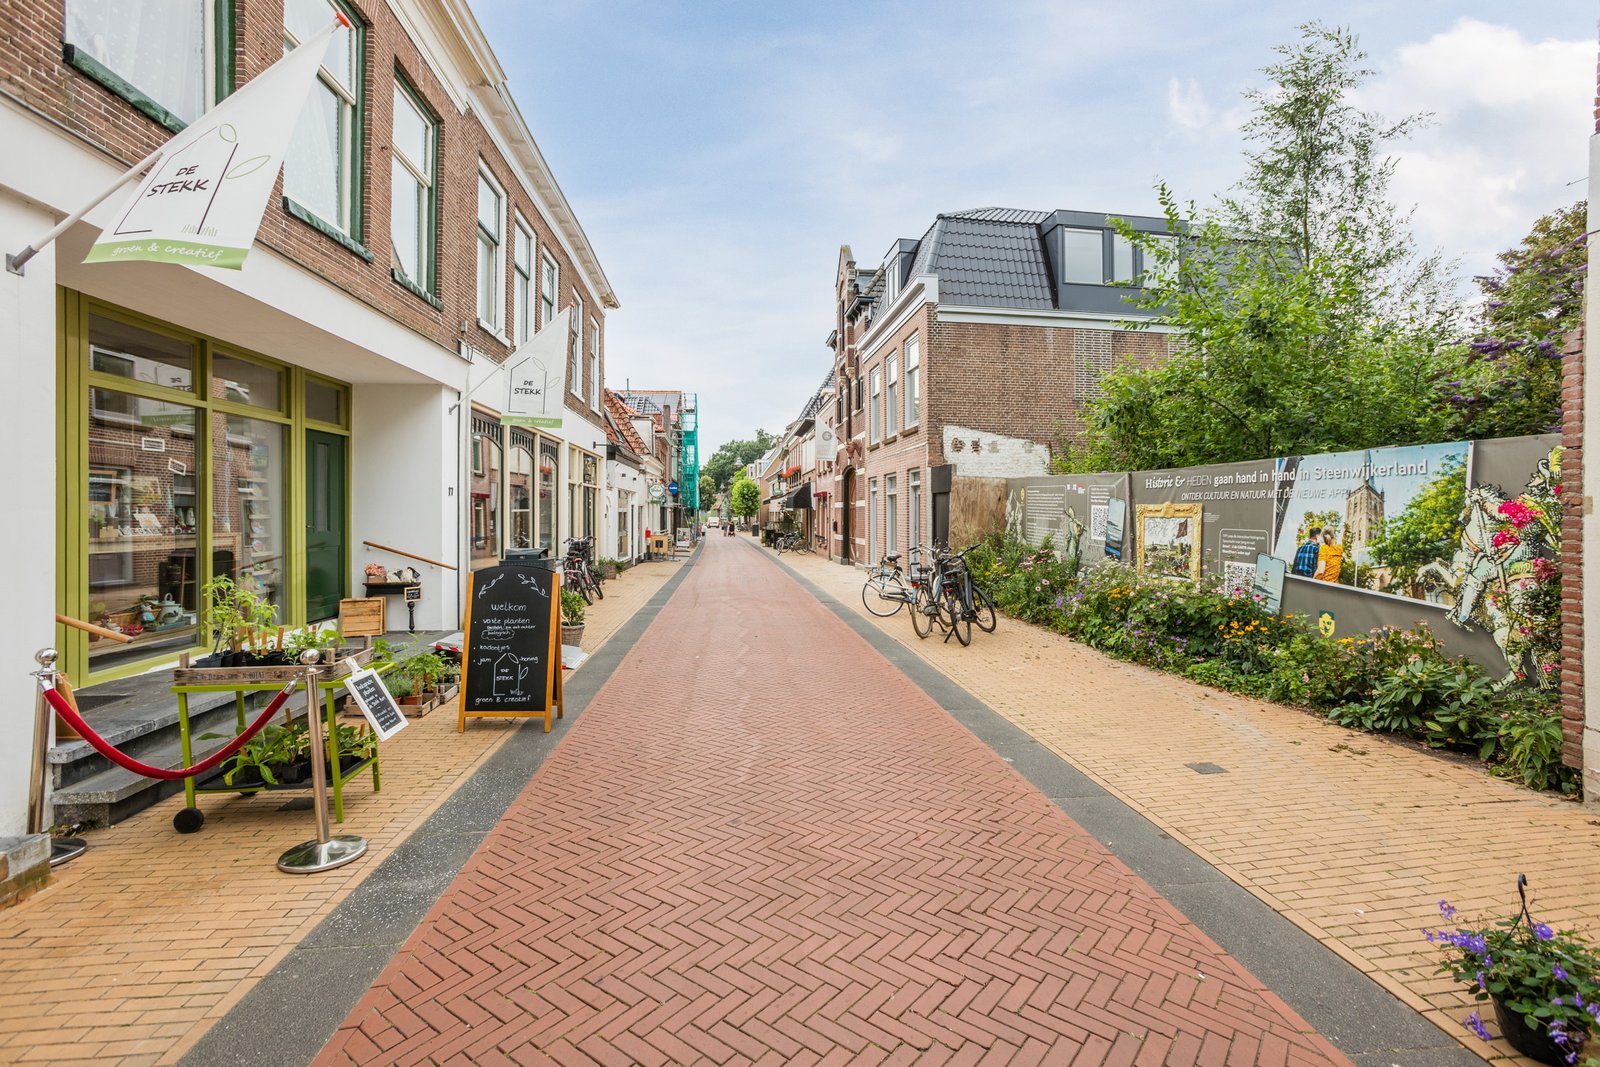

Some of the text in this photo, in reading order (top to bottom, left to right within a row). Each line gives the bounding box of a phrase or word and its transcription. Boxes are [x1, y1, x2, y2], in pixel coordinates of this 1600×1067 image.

[176, 165, 199, 176] DE
[147, 179, 209, 197] STEKK
[112, 242, 224, 261] groen & creatief
[514, 387, 541, 395] STEKK
[1145, 459, 1427, 490] Historie & HEDEN gaan hand in hand in Steenwijkerland
[1181, 493, 1202, 501] ONTDEK
[1203, 492, 1229, 500] CULTUUR
[1240, 490, 1266, 499] NATUUR
[1267, 490, 1282, 498] MET
[1283, 487, 1294, 499] DE
[1296, 488, 1326, 499] NIEUWE
[491, 602, 526, 611] welkom
[503, 617, 530, 626] planten
[477, 657, 491, 665] jam
[475, 697, 493, 705] groen
[504, 695, 531, 703] creatief
